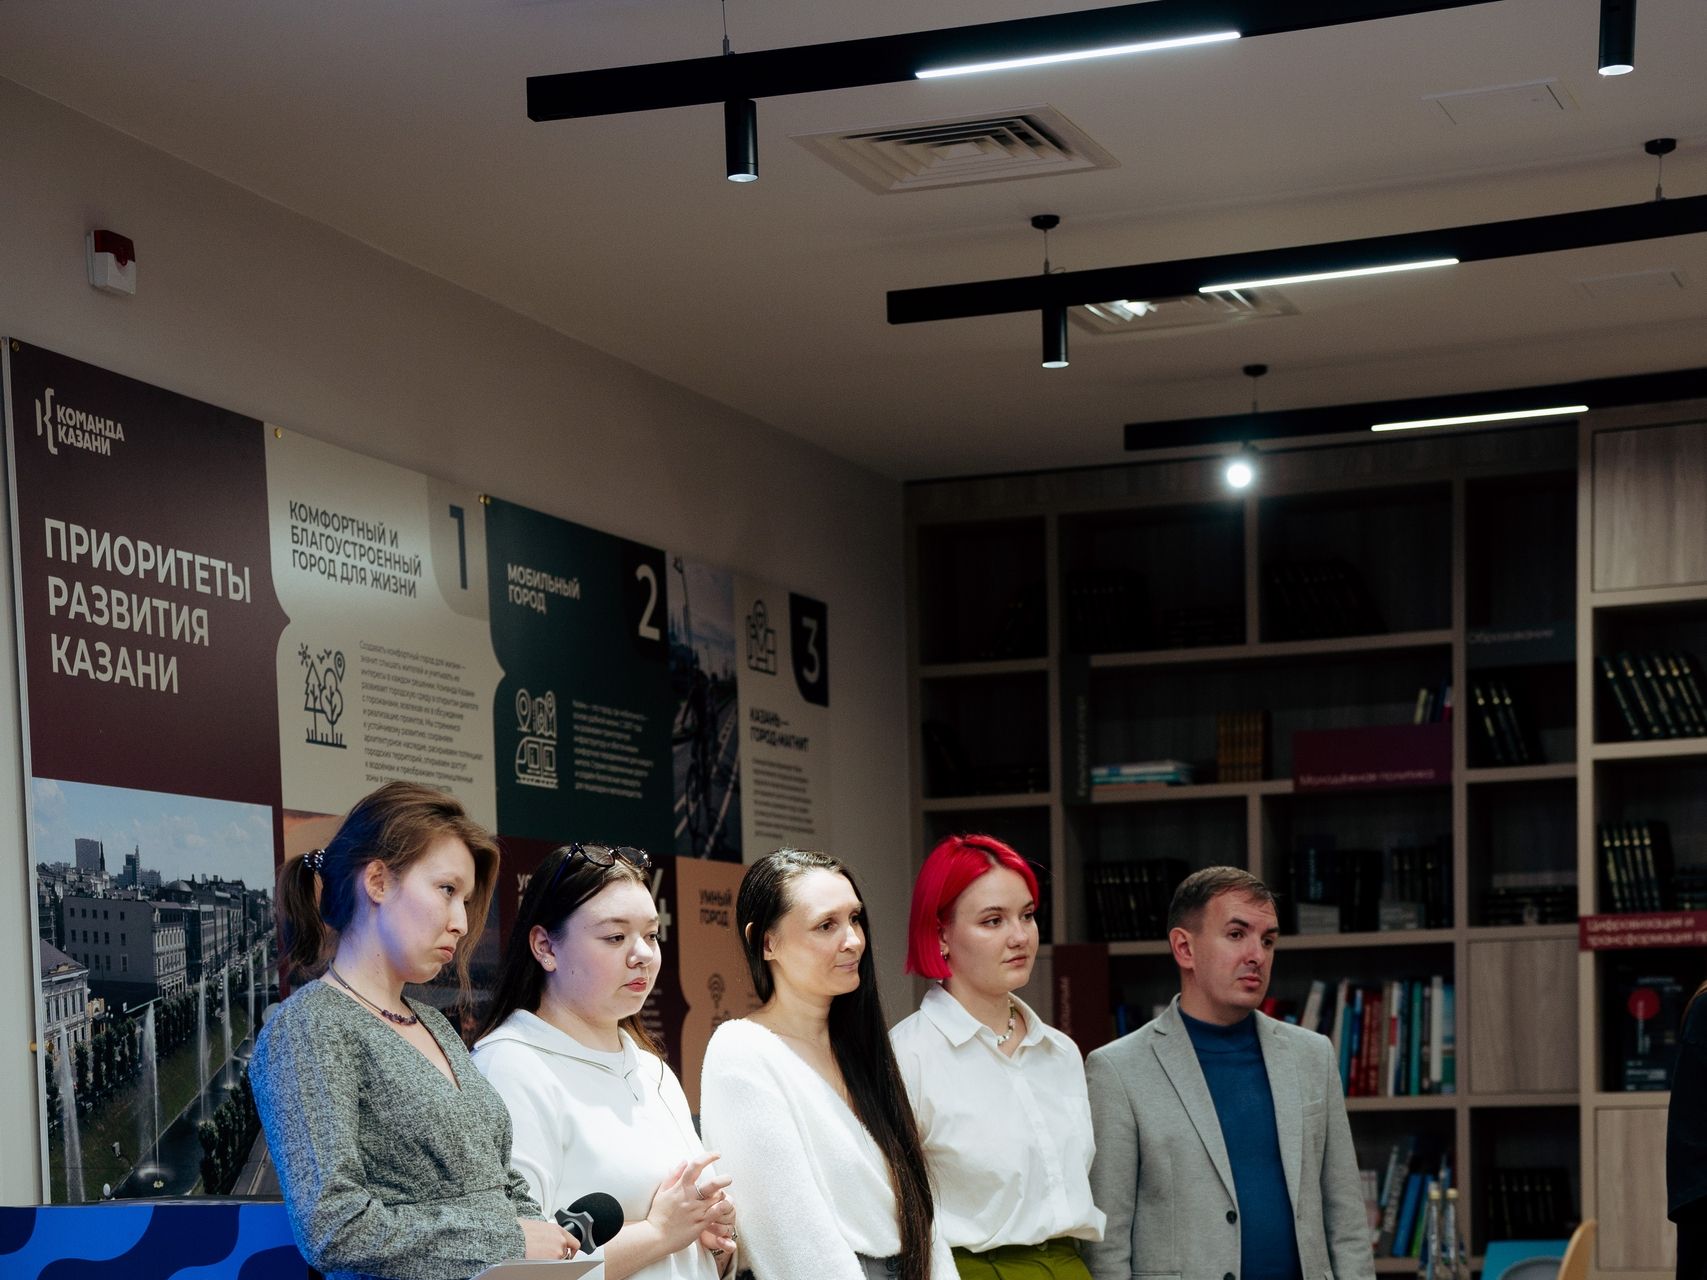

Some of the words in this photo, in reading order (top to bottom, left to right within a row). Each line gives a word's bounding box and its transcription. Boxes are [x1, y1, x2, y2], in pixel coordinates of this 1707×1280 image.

[56, 403, 125, 442] КОМАНДА
[57, 426, 112, 457] КАЗАНИ
[289, 500, 386, 545] КОМФОРТНЫЙ
[390, 525, 398, 549] И
[449, 503, 468, 591] 1
[44, 517, 251, 604] ПРИОРИТЕТЫ
[290, 525, 422, 578] БЛАГОУСТРОЕННЫЙ
[292, 549, 337, 584] ГОРОД
[340, 559, 368, 587] ДЛЯ
[370, 566, 417, 599] ЖИЗНИ
[507, 563, 581, 600] МОБИЛЬНЫЙ
[508, 585, 547, 614] ГОРОД
[635, 564, 662, 641] 2
[47, 576, 210, 647] РАЗВИТИЯ
[50, 633, 179, 694] КАЗАНИ
[801, 617, 822, 684] 3
